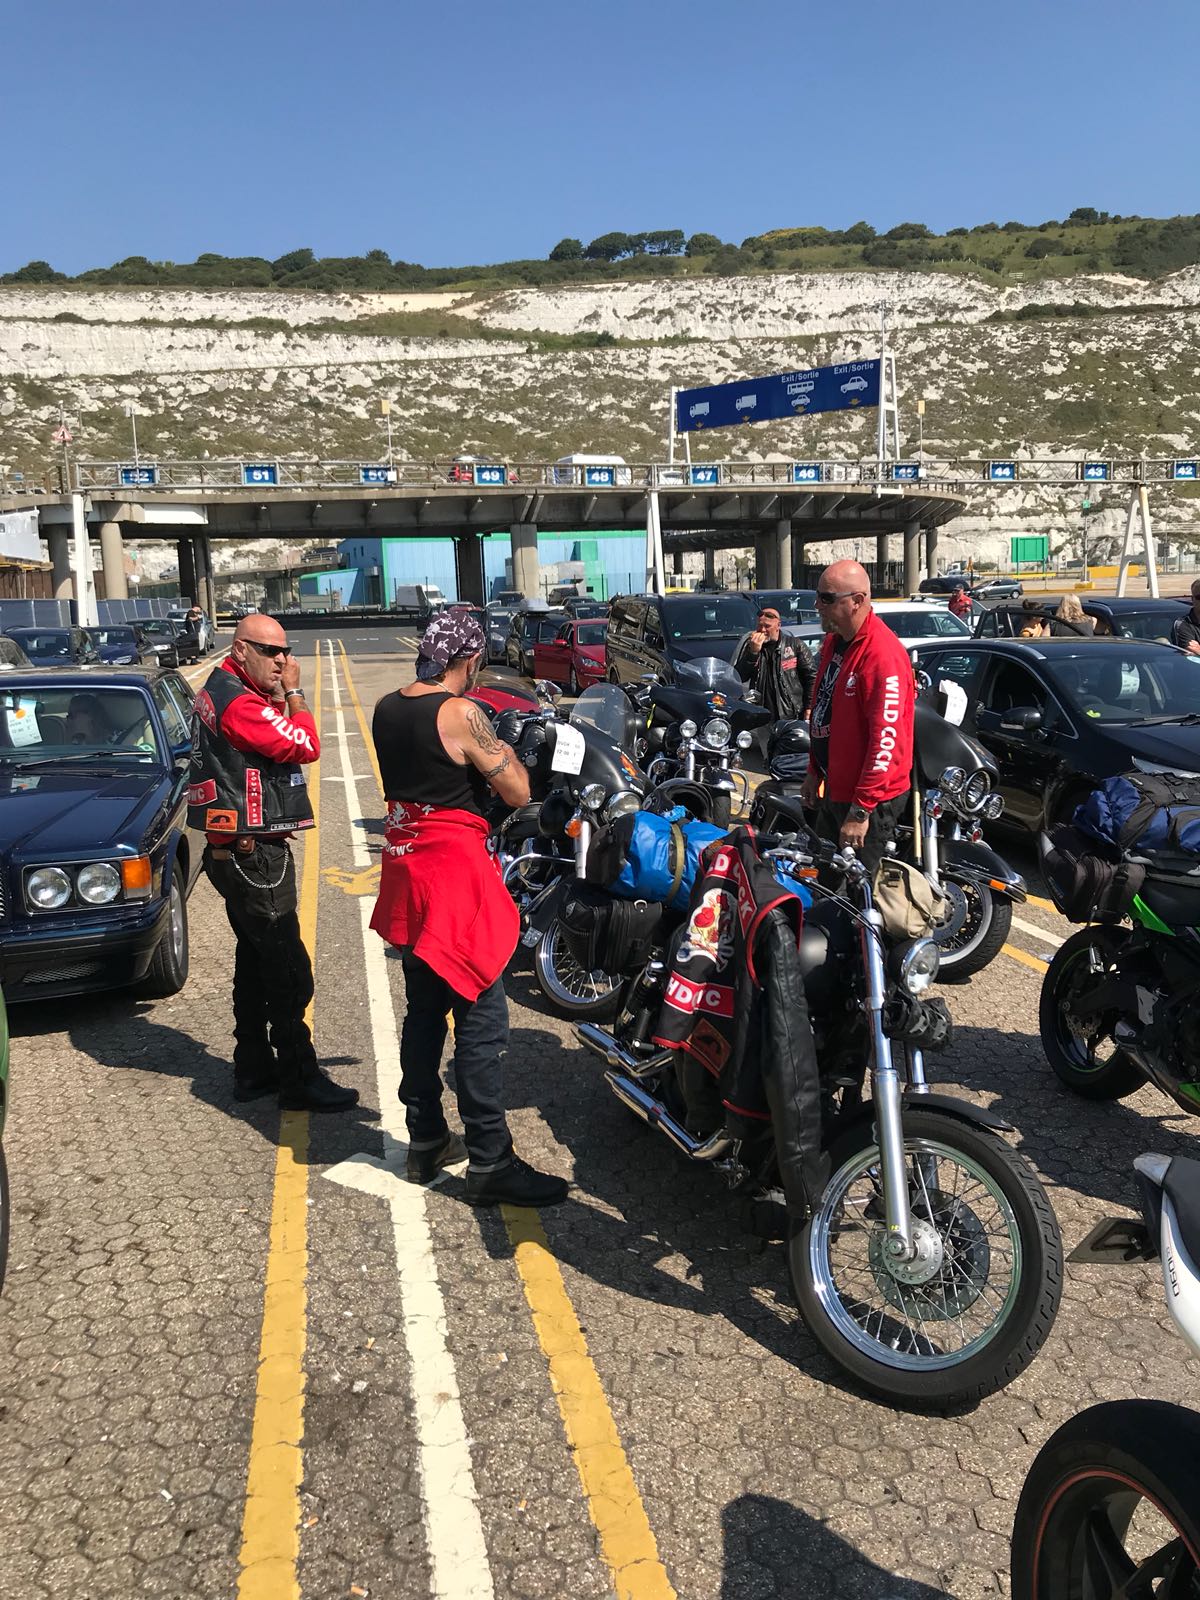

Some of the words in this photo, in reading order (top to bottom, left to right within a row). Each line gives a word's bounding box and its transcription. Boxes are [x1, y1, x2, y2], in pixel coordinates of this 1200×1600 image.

[252, 470, 269, 481] 51
[481, 470, 500, 481] 49
[798, 468, 815, 479] 46
[994, 467, 1010, 476] 44
[1087, 466, 1103, 476] 43
[1177, 465, 1193, 475] 42
[591, 471, 609, 482] 48
[696, 471, 713, 482] 47
[883, 676, 899, 723] WILD
[872, 726, 897, 772] COCK
